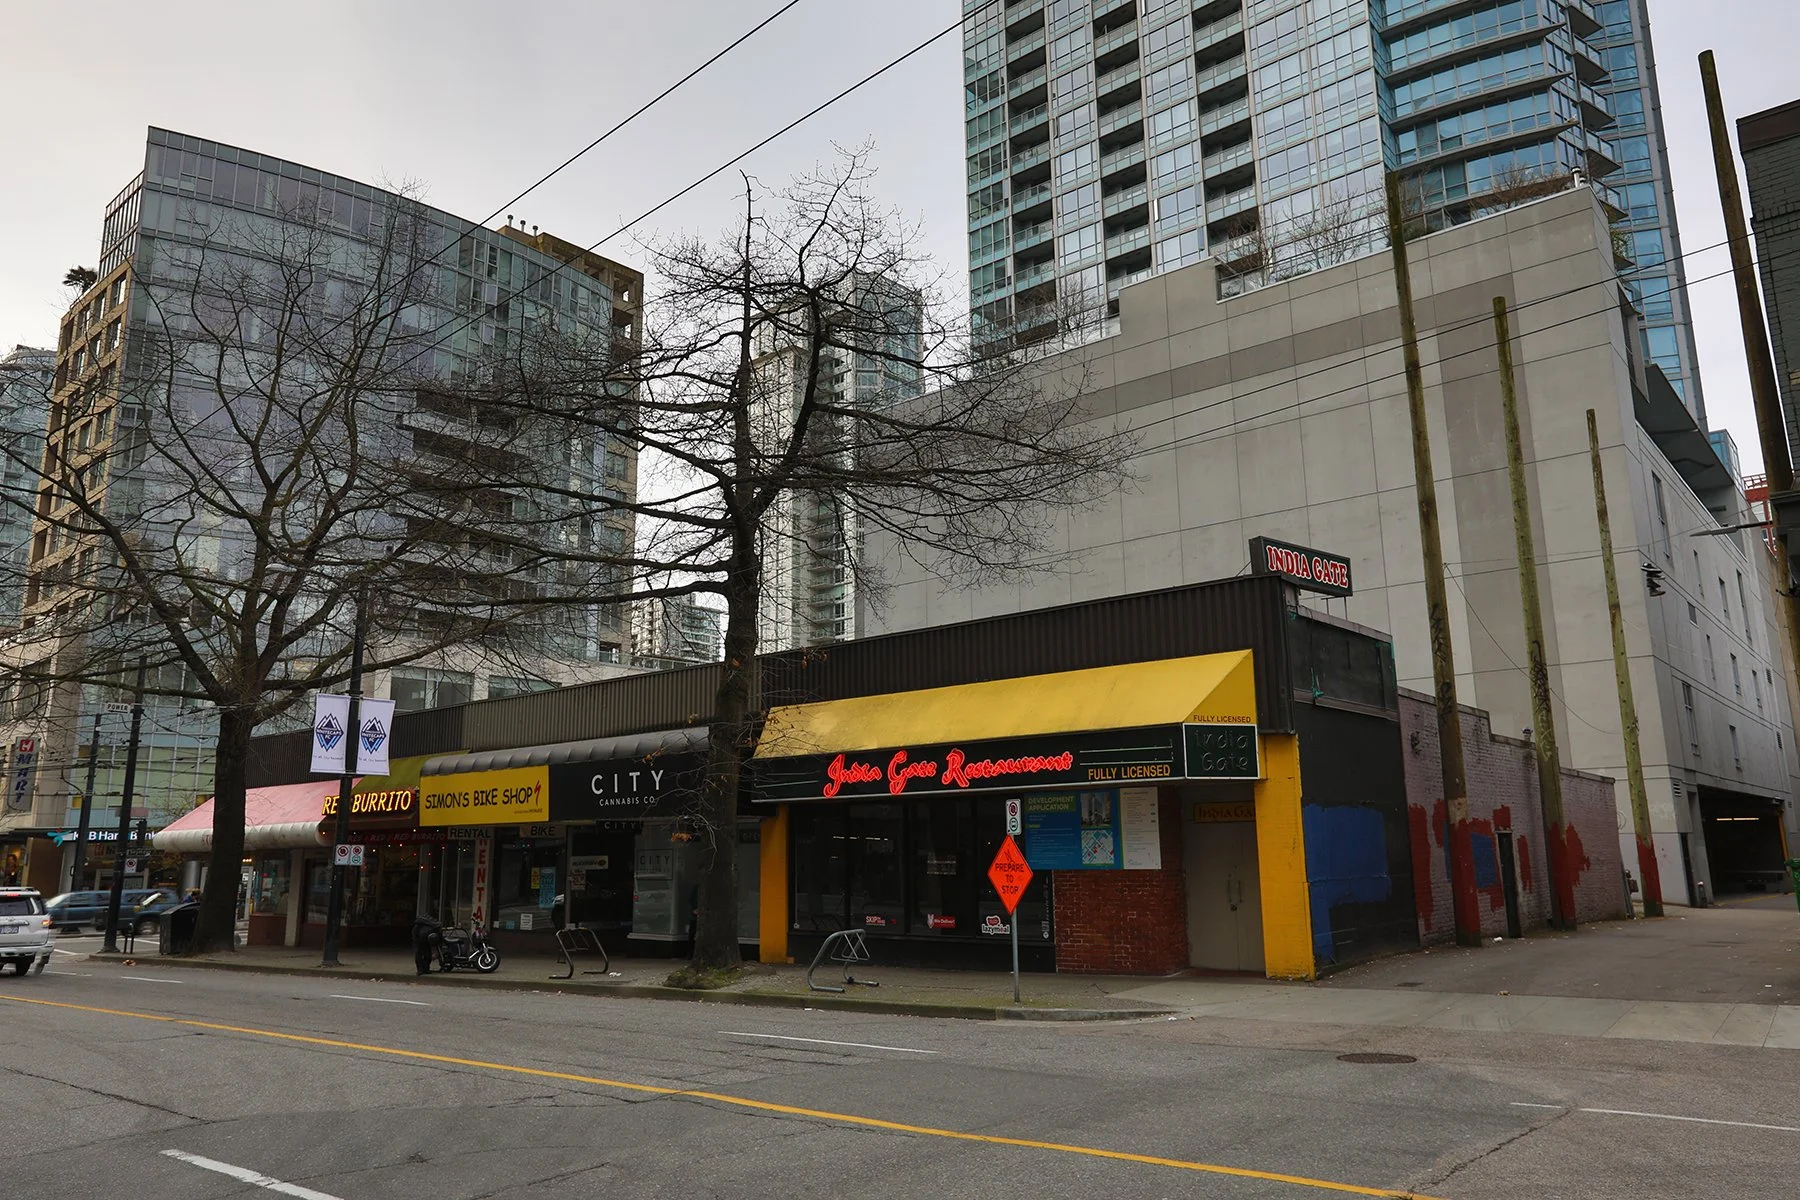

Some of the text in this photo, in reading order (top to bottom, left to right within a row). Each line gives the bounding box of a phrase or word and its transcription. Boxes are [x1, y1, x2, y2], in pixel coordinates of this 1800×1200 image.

[1266, 545, 1348, 588] INDIA GATE
[107, 703, 128, 711] POWER
[1193, 714, 1252, 723] FULLY LICENSED
[822, 748, 1073, 798] India Gate Restaurant
[1088, 764, 1171, 781] FULLY LICENSED
[591, 769, 664, 795] CITY
[321, 790, 411, 816] RE BURRITO
[425, 787, 533, 809] SIMON'S BIKE SHOP
[599, 797, 640, 807] CANNABIS
[1028, 795, 1074, 804] DEVELOPMENT
[1028, 803, 1069, 811] APPLICATION
[603, 821, 637, 830] CITY
[130, 830, 156, 841] Bnk
[449, 826, 556, 838] RENTAL BIKE
[639, 855, 671, 865] CITY
[995, 863, 1025, 873] PREPARE
[1005, 874, 1014, 884] TO
[1001, 885, 1019, 894] STOP
[982, 924, 1009, 935] lazymeal
